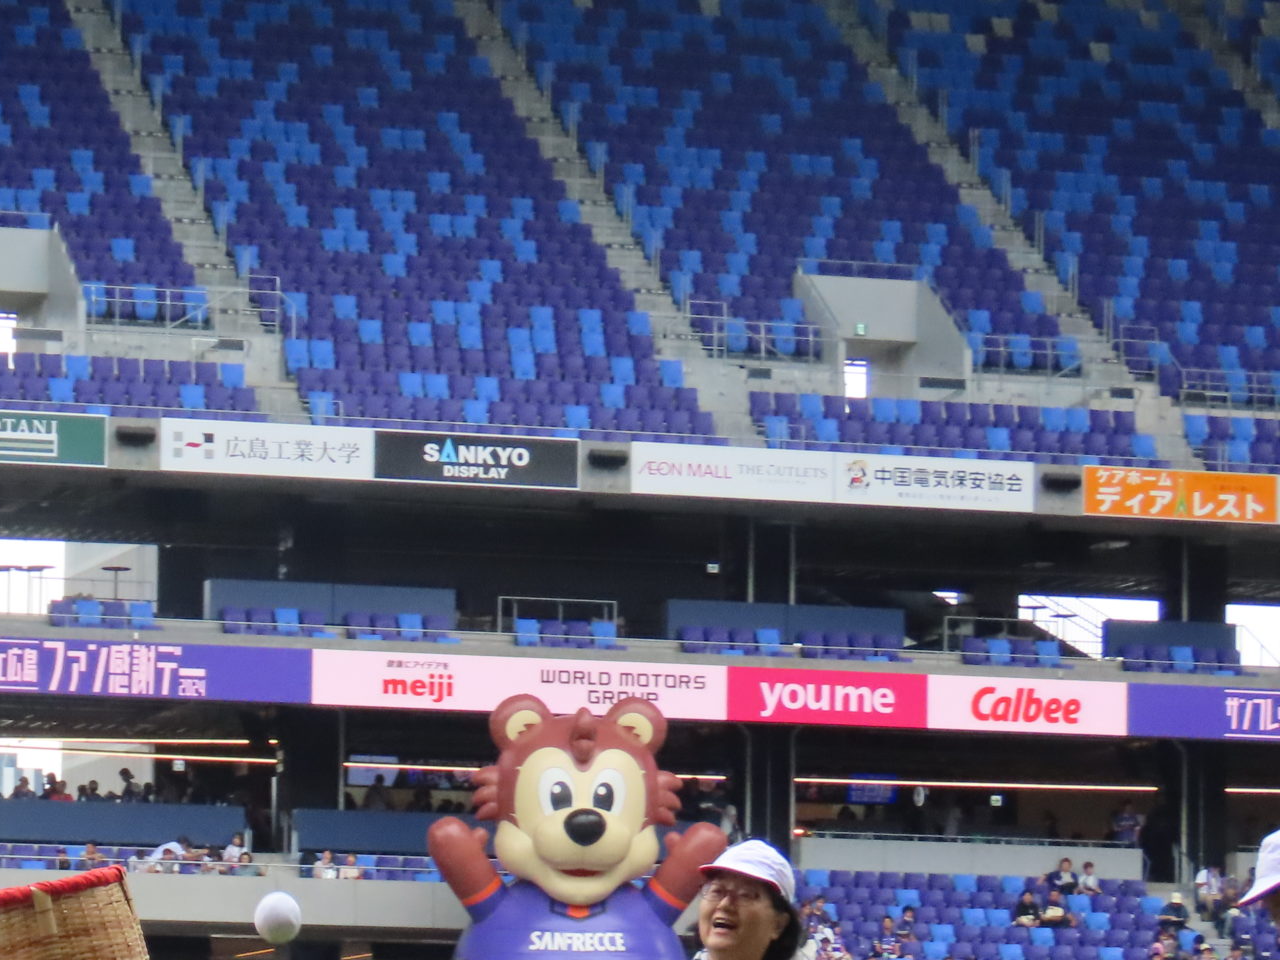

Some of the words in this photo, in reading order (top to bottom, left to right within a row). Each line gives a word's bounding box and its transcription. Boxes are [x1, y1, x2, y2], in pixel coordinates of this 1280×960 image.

[224, 436, 360, 464] 広島工業大学
[423, 438, 530, 466] SANKYO
[443, 465, 509, 479] DISPLAY
[687, 463, 732, 479] MALL
[874, 467, 1023, 492] 中国電気保安協会
[1096, 469, 1172, 486] ケアホーム
[383, 673, 453, 703] meiji
[540, 669, 611, 686] WORLD
[620, 673, 706, 690] MOTORS
[761, 681, 895, 714] youme
[972, 686, 1081, 724] Calbee
[529, 931, 626, 951] SANFRECCE
